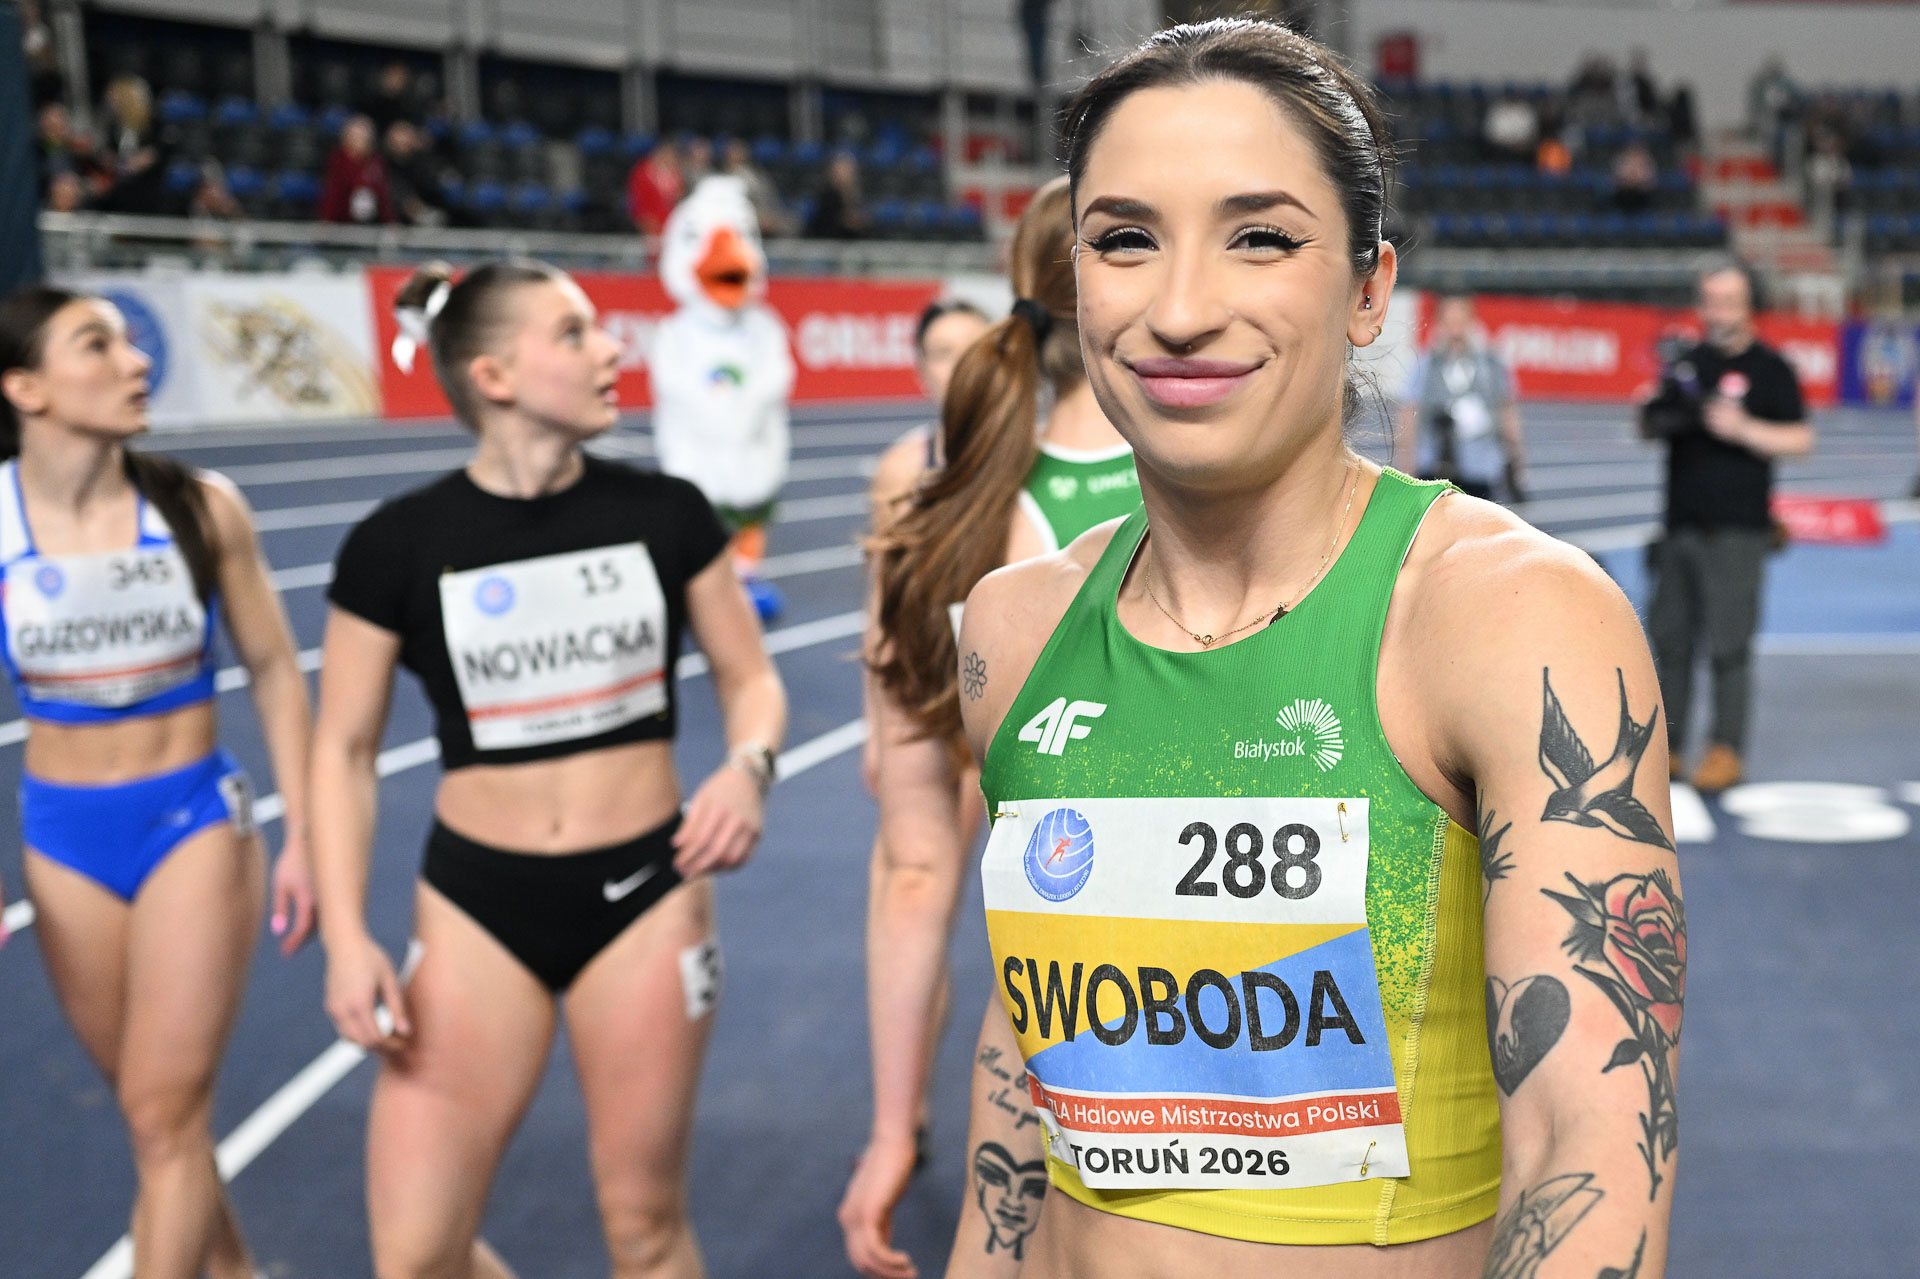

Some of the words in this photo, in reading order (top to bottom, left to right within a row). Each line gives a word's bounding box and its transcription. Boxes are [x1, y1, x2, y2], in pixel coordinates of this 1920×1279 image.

[579, 559, 622, 596] 15
[18, 609, 194, 656] GUZOWSKA
[462, 619, 657, 685] NOWACKA
[1018, 697, 1107, 756] 4F
[1234, 736, 1306, 762] Białystok
[1175, 821, 1322, 900] 288
[1003, 955, 1366, 1052] SWOBODA
[1075, 1103, 1154, 1126] Halowe
[1162, 1104, 1300, 1130] Mistrzostwa
[1308, 1099, 1380, 1125] Polski
[1070, 1139, 1189, 1174] TORUŃ
[1199, 1147, 1290, 1176] 2026
